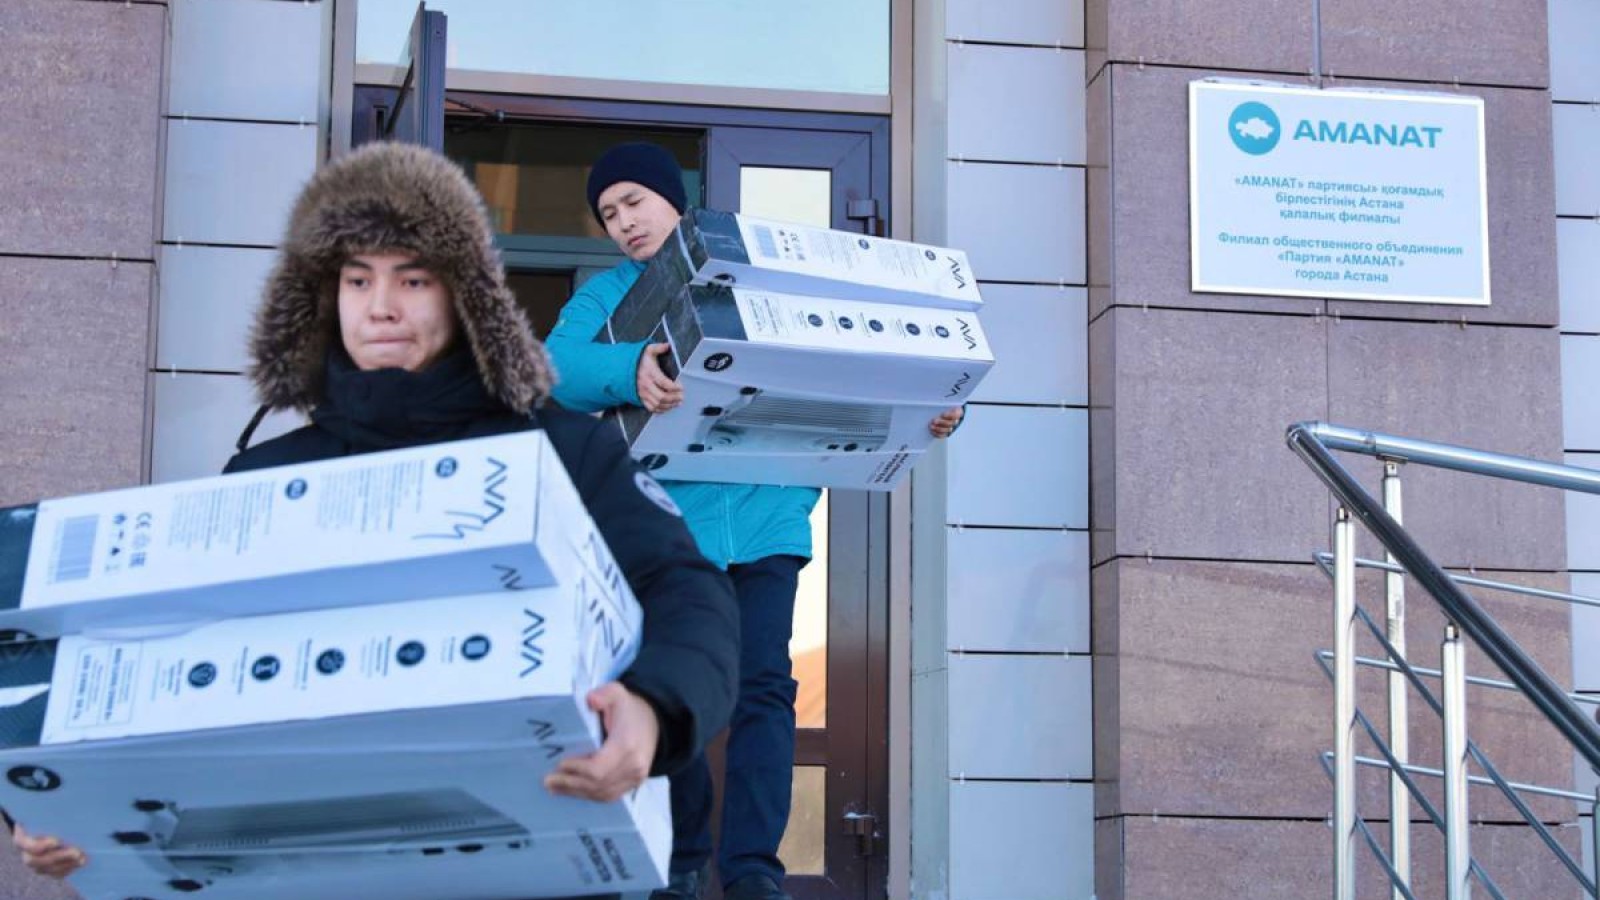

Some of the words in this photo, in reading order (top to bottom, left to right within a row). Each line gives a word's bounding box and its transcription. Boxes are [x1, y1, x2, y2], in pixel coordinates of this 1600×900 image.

[1293, 119, 1443, 149] AMANAT
[1359, 197, 1405, 210] Астана
[1338, 211, 1401, 225] филиалы
[1218, 232, 1270, 245] Филиал
[1272, 236, 1373, 251] общественного
[1376, 241, 1464, 255] объединения
[1295, 268, 1341, 281] города
[1343, 270, 1389, 283] Астана
[519, 608, 545, 677] AVA
